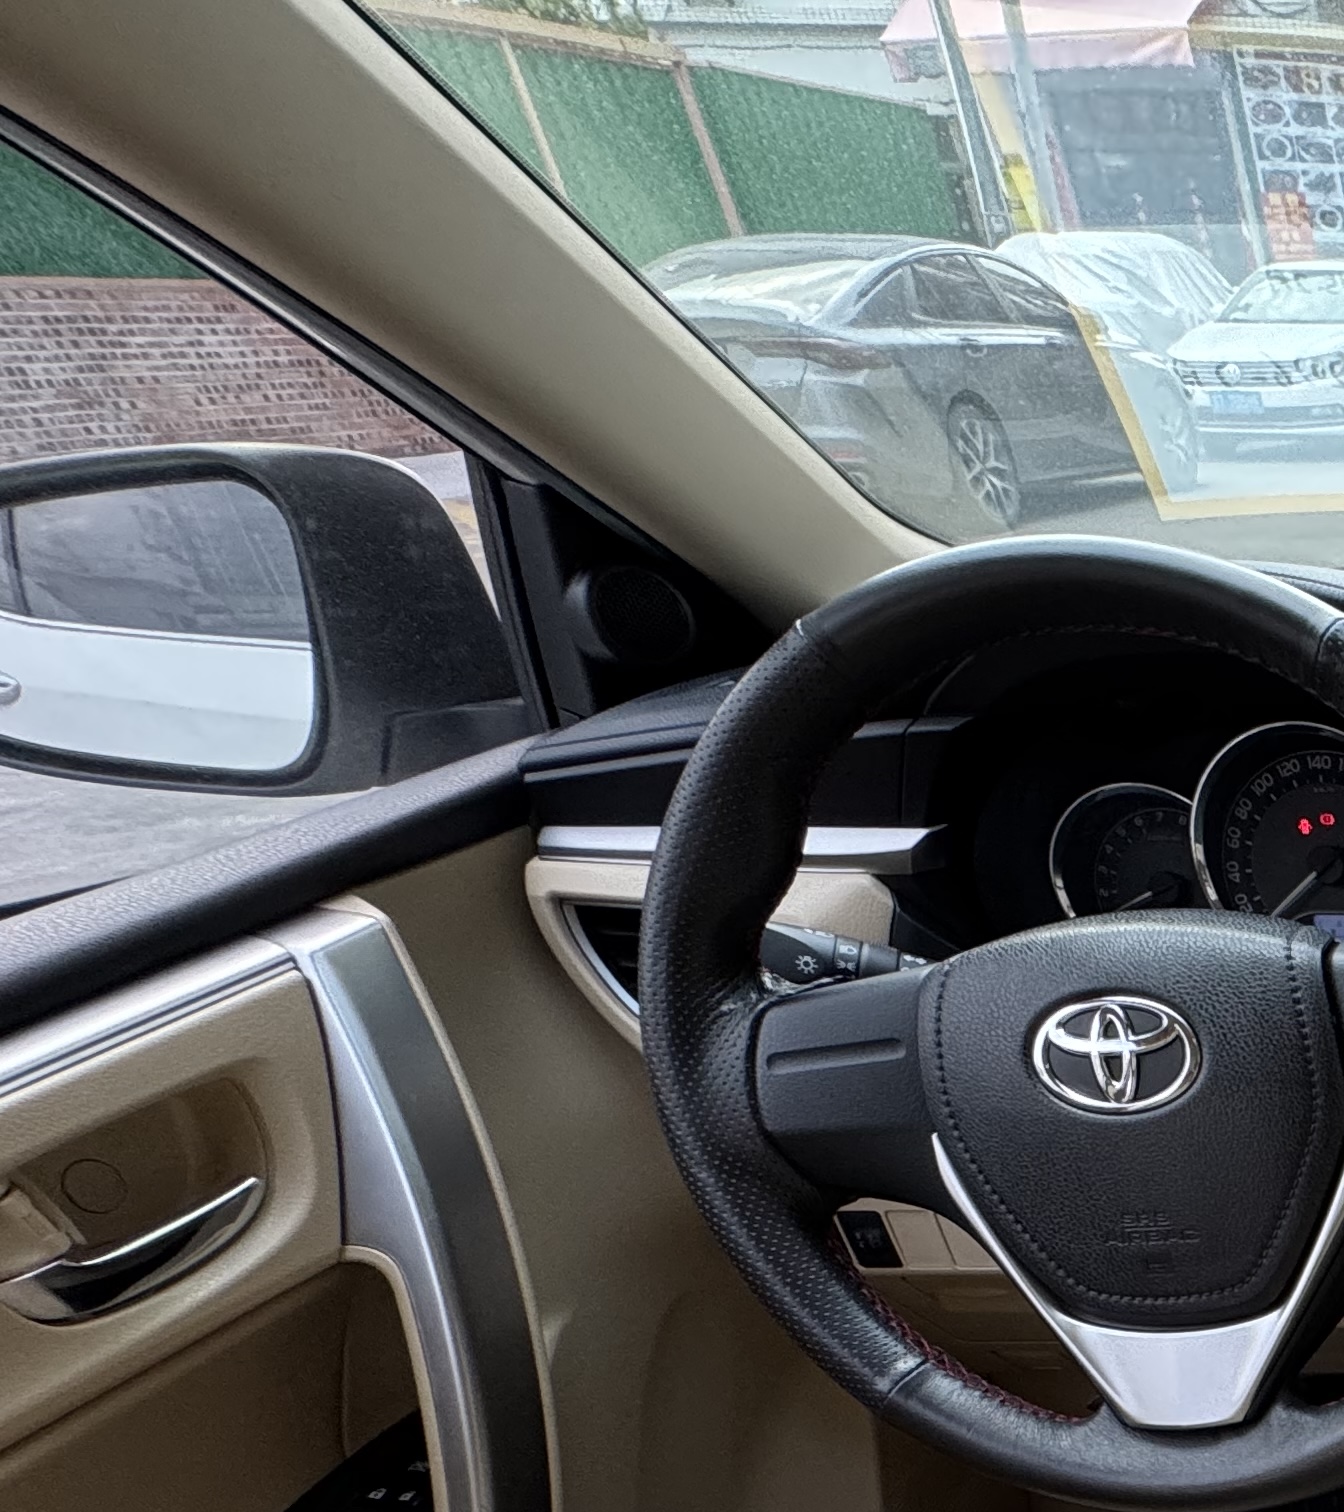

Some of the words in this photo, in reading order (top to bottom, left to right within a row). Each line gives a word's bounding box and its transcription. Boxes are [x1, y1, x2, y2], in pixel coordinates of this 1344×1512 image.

[1276, 758, 1300, 778] 120
[1306, 755, 1332, 770] 140
[1251, 774, 1274, 798] 100
[1234, 798, 1253, 821] 80
[1226, 826, 1242, 849] 60
[1226, 861, 1241, 883] 40
